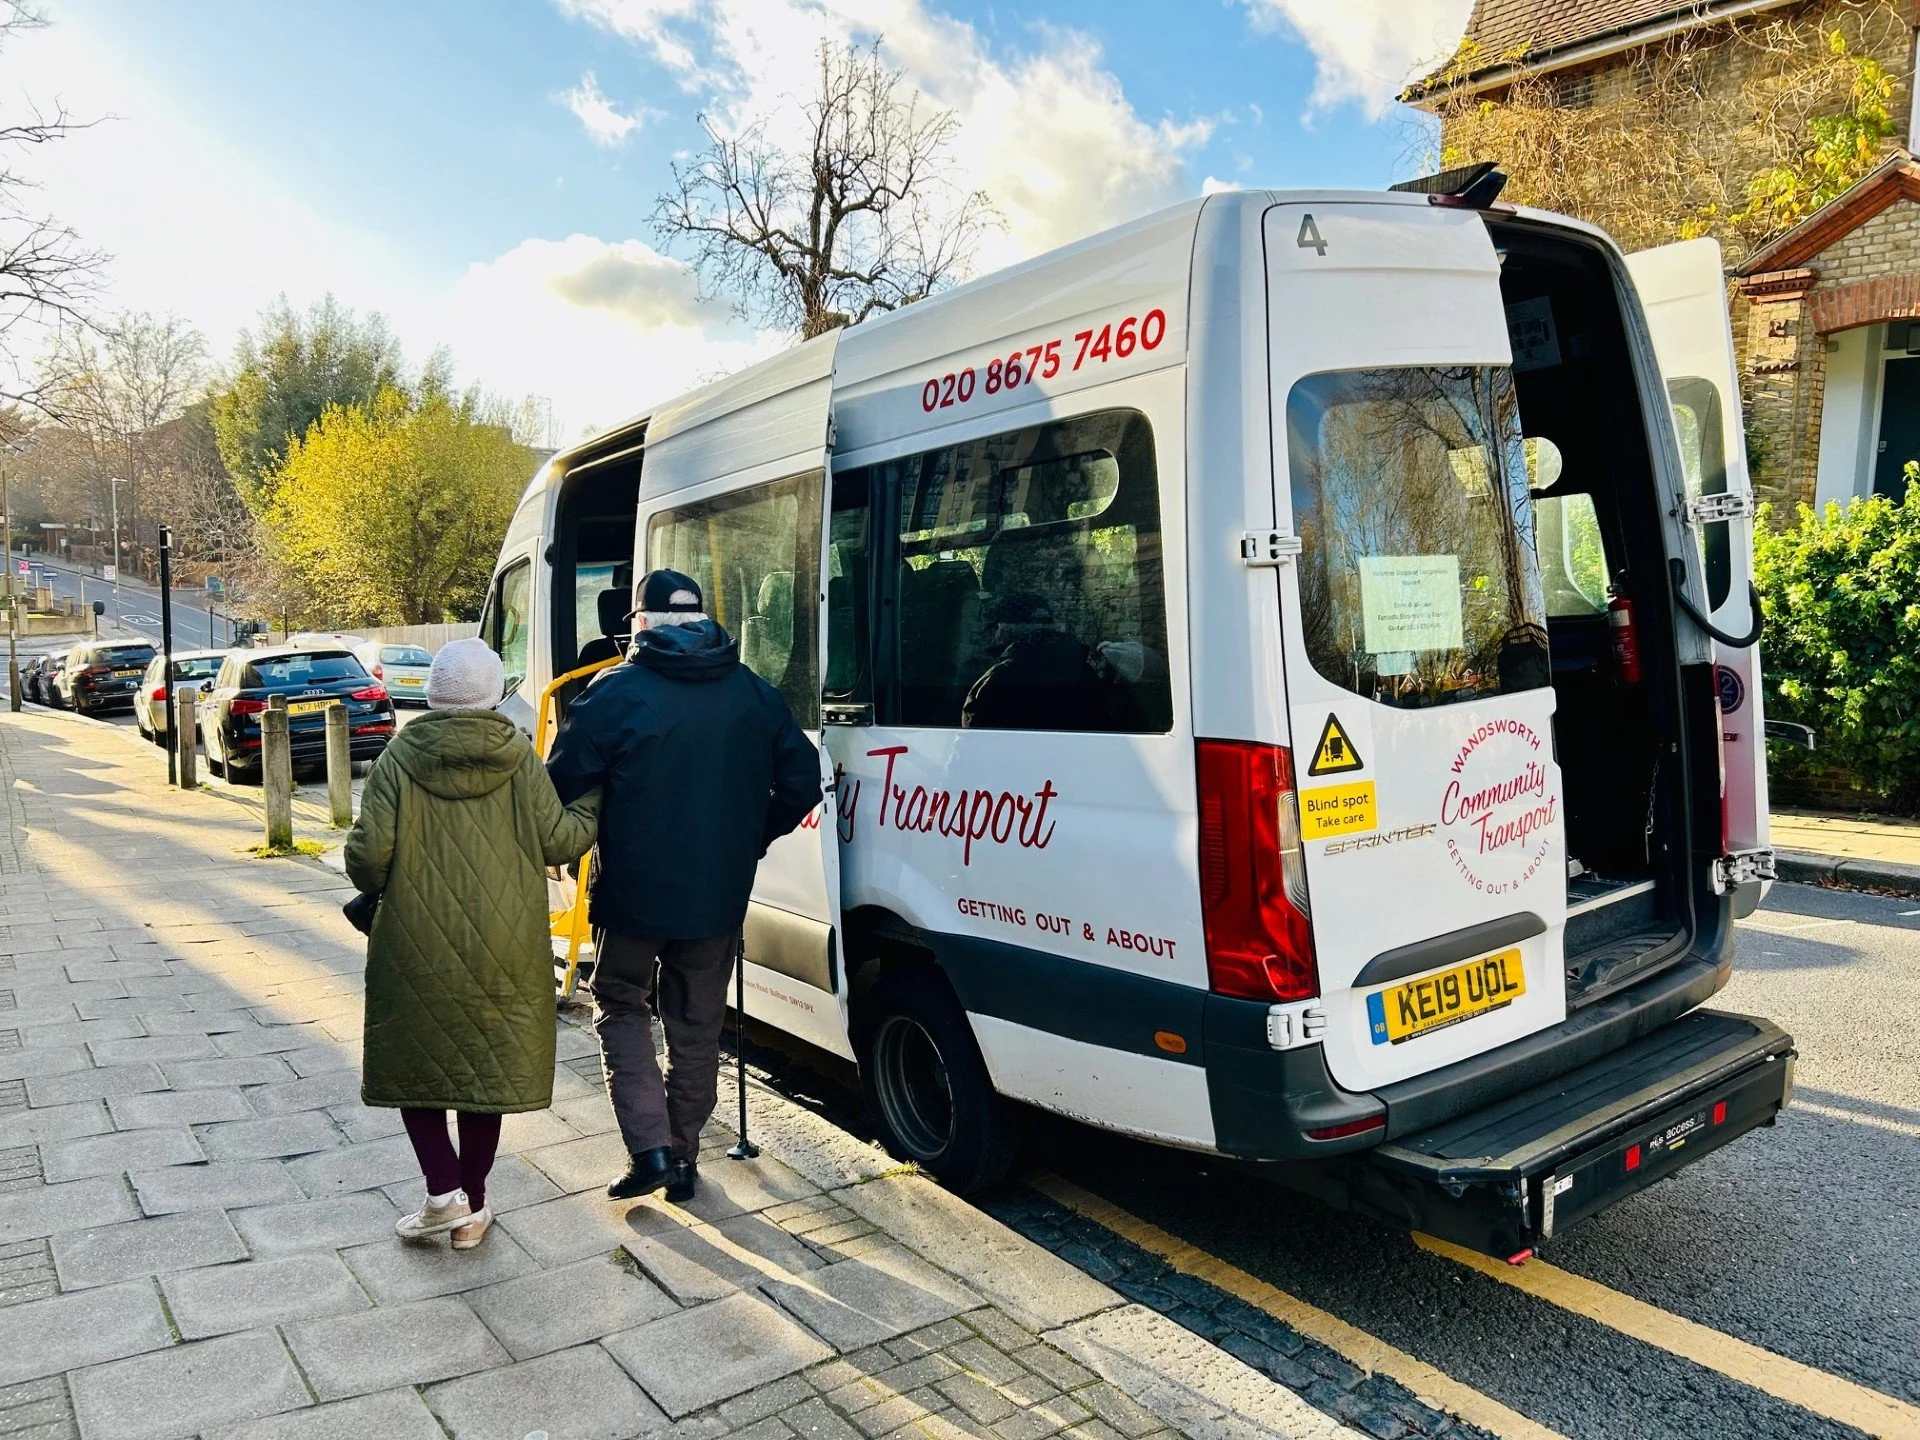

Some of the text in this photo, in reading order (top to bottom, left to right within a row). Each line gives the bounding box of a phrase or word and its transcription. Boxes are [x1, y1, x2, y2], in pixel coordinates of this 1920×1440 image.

[1296, 213, 1328, 257] 4
[922, 308, 1166, 413] 020 8675 7460
[1451, 719, 1541, 774] WANDSWORTH
[866, 745, 1059, 867] Transport
[1307, 793, 1370, 812] Blind spot
[1316, 813, 1365, 828] Take care
[1441, 761, 1546, 826] Community
[1323, 822, 1438, 857] SPRINTER
[1470, 795, 1556, 855] Transport
[1447, 839, 1550, 894] GETTING OUT & ABOUT
[957, 896, 1177, 960] GETTING OUT & ABOUT
[1397, 959, 1518, 1026] KE19 UOL
[1374, 1022, 1386, 1034] GB
[1666, 1118, 1695, 1139] access
